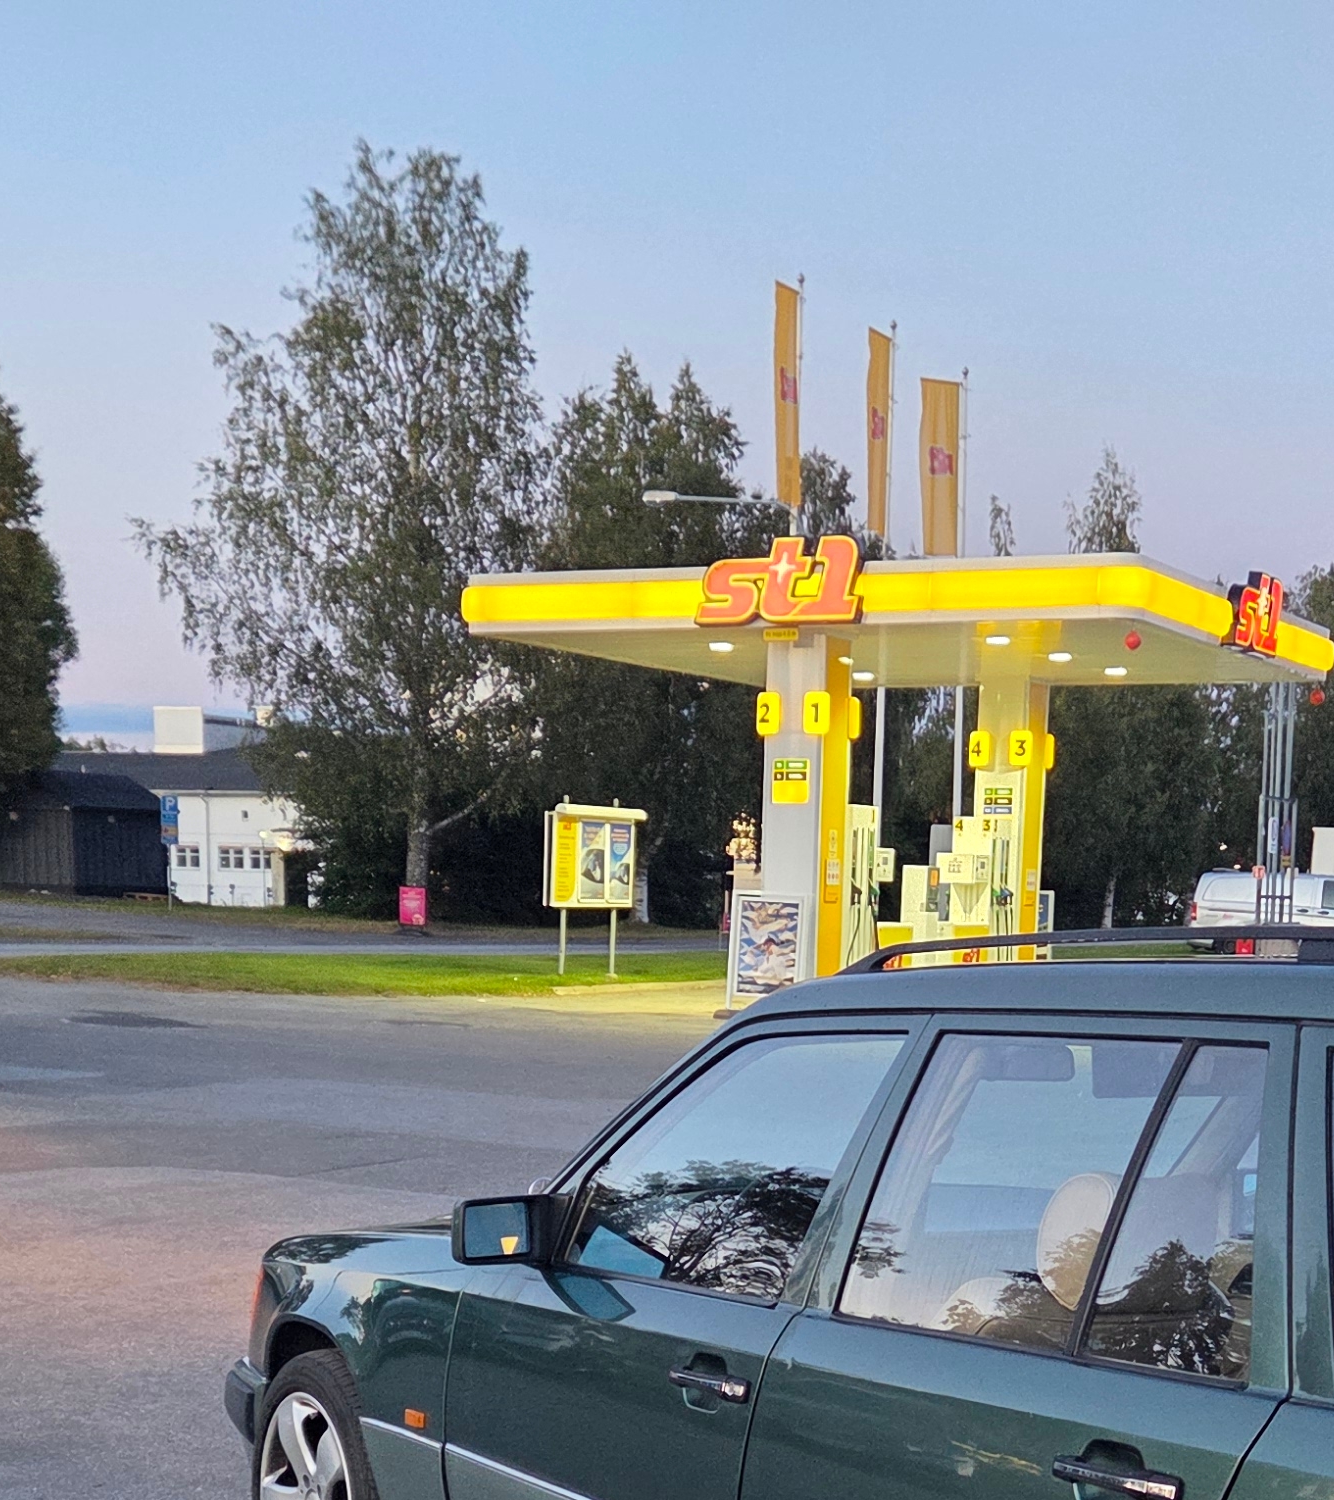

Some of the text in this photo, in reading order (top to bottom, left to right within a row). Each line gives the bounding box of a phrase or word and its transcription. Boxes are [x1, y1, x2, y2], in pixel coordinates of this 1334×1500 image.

[759, 703, 770, 723] 2
[811, 702, 819, 723] 1
[971, 740, 982, 757] 4
[1014, 740, 1026, 757] 3
[165, 797, 176, 811] P
[955, 819, 963, 831] 4
[983, 819, 991, 831] 3
